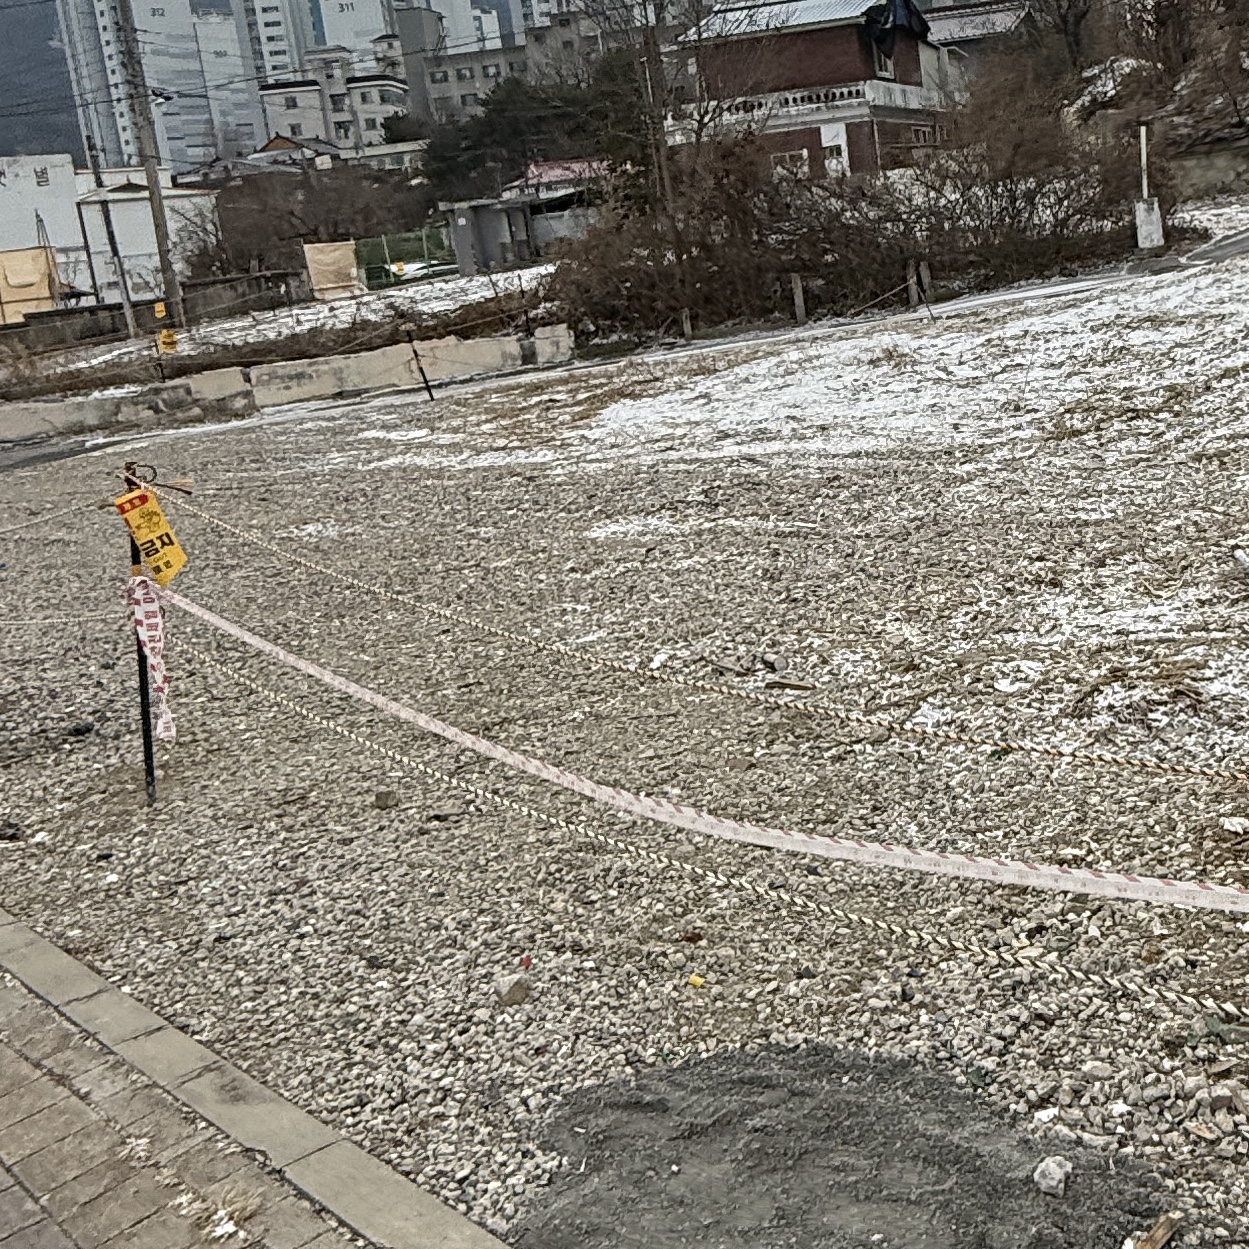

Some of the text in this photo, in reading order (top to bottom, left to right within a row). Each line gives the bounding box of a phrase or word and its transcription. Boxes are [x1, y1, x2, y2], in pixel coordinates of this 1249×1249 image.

[150, 7, 165, 17] 312
[338, 2, 355, 13] 311
[140, 532, 175, 558] 금지
